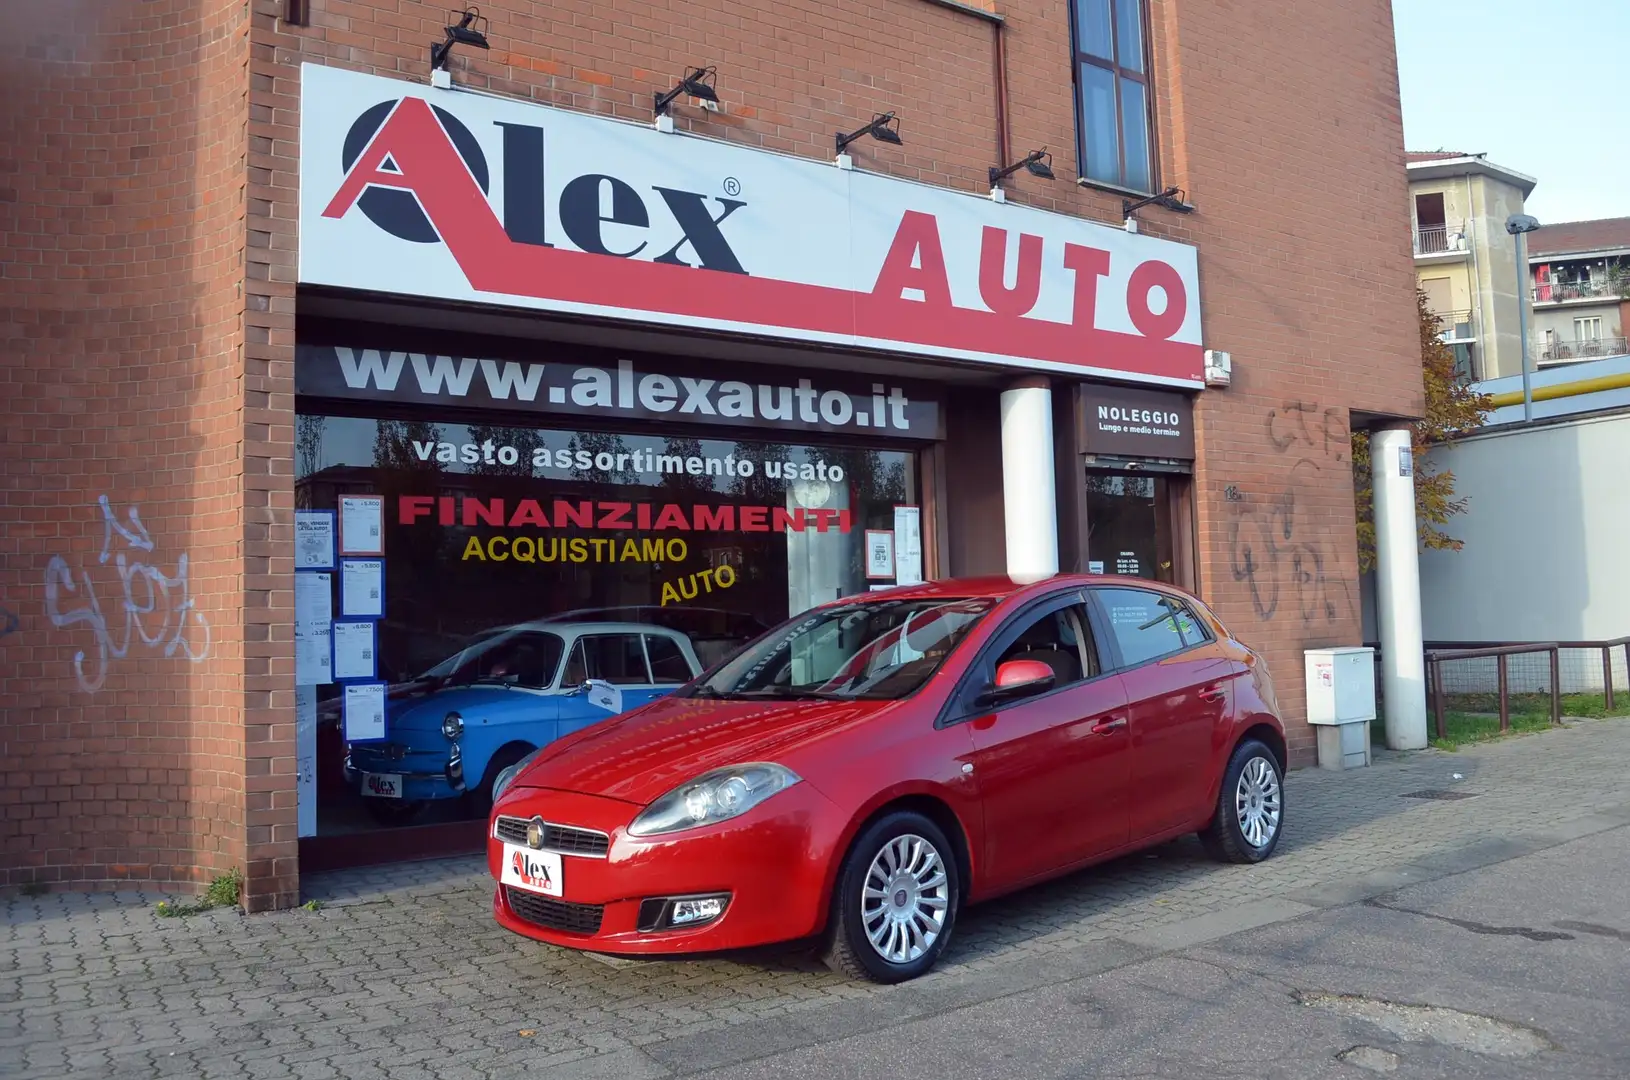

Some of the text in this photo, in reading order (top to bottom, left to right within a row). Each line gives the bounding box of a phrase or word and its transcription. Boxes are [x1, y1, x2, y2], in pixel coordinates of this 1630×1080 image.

[321, 96, 749, 290] Alex
[872, 209, 1187, 340] AUTO
[334, 346, 910, 430] www.alexauto.it
[1097, 406, 1179, 426] NOLEGGIO
[1099, 422, 1122, 433] Lungo
[1129, 426, 1151, 434] medio
[1153, 427, 1180, 436] termine
[412, 438, 844, 483] vasto assortimento usato
[400, 496, 851, 533] FINANZIAMENTI
[462, 536, 688, 563] ACQUISTIAMO
[660, 565, 736, 608] AUTO
[512, 851, 551, 884] Alex
